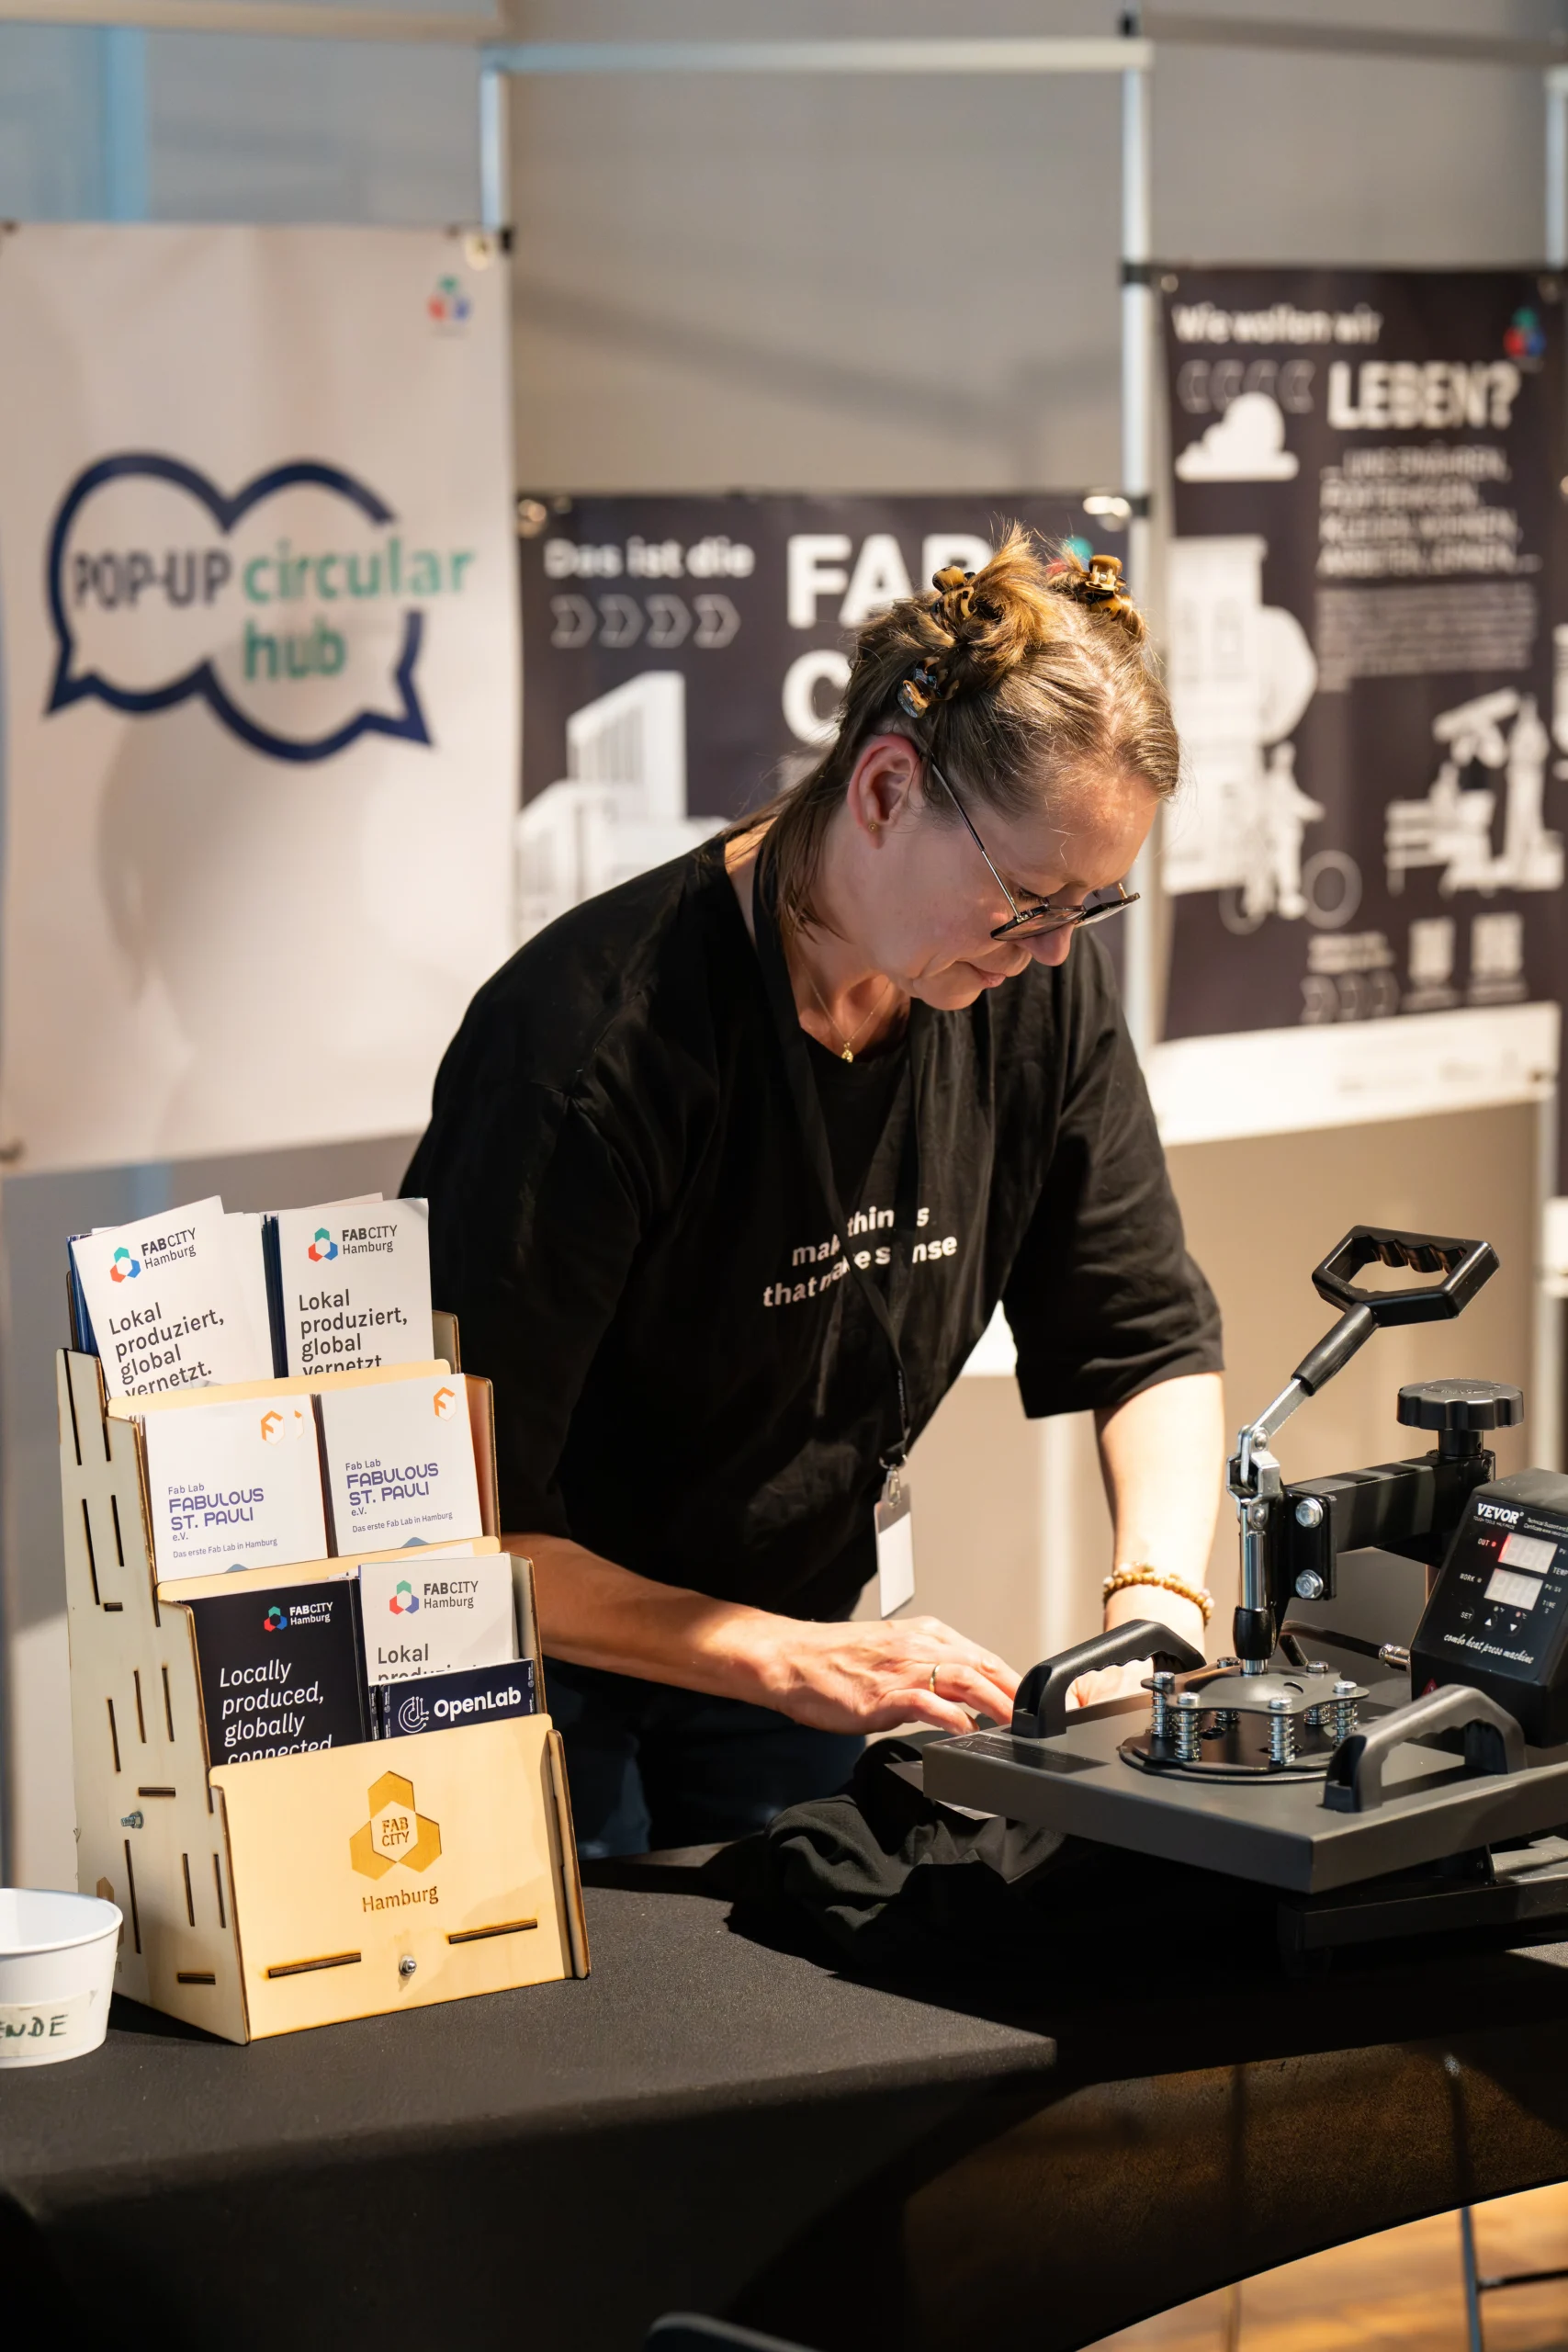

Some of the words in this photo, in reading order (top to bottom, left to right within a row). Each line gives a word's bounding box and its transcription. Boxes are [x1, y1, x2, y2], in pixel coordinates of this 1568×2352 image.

[1327, 359, 1521, 430] LEBEN?
[545, 537, 623, 579] Das
[626, 535, 683, 579] ist
[687, 535, 756, 579] die
[74, 548, 232, 610] POP-UP
[243, 537, 475, 603] circular
[243, 616, 346, 683] hub
[343, 1240, 394, 1255] Hamburg
[792, 1234, 840, 1266] mak
[847, 1206, 930, 1237] thins
[144, 1245, 197, 1269] Hamburg
[762, 1276, 818, 1307] that
[874, 1236, 958, 1265] snse
[299, 1288, 350, 1311] Lokal
[108, 1302, 162, 1335] Lokal
[300, 1307, 408, 1340] produziert,
[116, 1309, 224, 1363] produziert,
[301, 1333, 361, 1363] global
[120, 1343, 181, 1385] global
[125, 1361, 212, 1396] vernetzt.
[345, 1461, 363, 1471] Fab
[365, 1459, 381, 1469] Lab
[346, 1463, 439, 1489] FABULOUS
[168, 1485, 186, 1495] Fab
[187, 1483, 205, 1493] Lab
[169, 1487, 264, 1513] FABULOUS
[349, 1489, 377, 1506] ST.
[381, 1481, 430, 1502] PAULI
[171, 1514, 198, 1531] ST.
[204, 1507, 254, 1527] PAULI
[351, 1507, 367, 1517] e.V.
[352, 1525, 367, 1533] Das
[367, 1522, 385, 1531] erste
[386, 1520, 400, 1528] Fab
[400, 1518, 413, 1526] Lab
[422, 1512, 453, 1522] Hamburg
[173, 1532, 188, 1542] e.V.
[187, 1548, 207, 1556] erste
[208, 1545, 221, 1554] Fab
[223, 1544, 236, 1552] Lab
[245, 1538, 278, 1548] Hamburg
[1478, 1538, 1490, 1546] OUT
[1460, 1573, 1475, 1582] WORK
[423, 1596, 474, 1609] Hamburg
[290, 1613, 331, 1625] Hamburg
[1461, 1611, 1472, 1620] SET
[378, 1643, 429, 1665] Lokal
[1444, 1634, 1466, 1645] combo
[1466, 1636, 1484, 1650] heat
[1480, 1643, 1503, 1656] press
[1503, 1649, 1534, 1664] machine
[220, 1658, 292, 1688] Locally
[222, 1680, 324, 1720] produced,
[434, 1687, 522, 1722] OpenLab
[224, 1712, 305, 1747] globally
[382, 1817, 409, 1833] FAB
[382, 1831, 410, 1847] CITY
[362, 1886, 439, 1912] Hamburg
[0, 2015, 69, 2038] NDE
